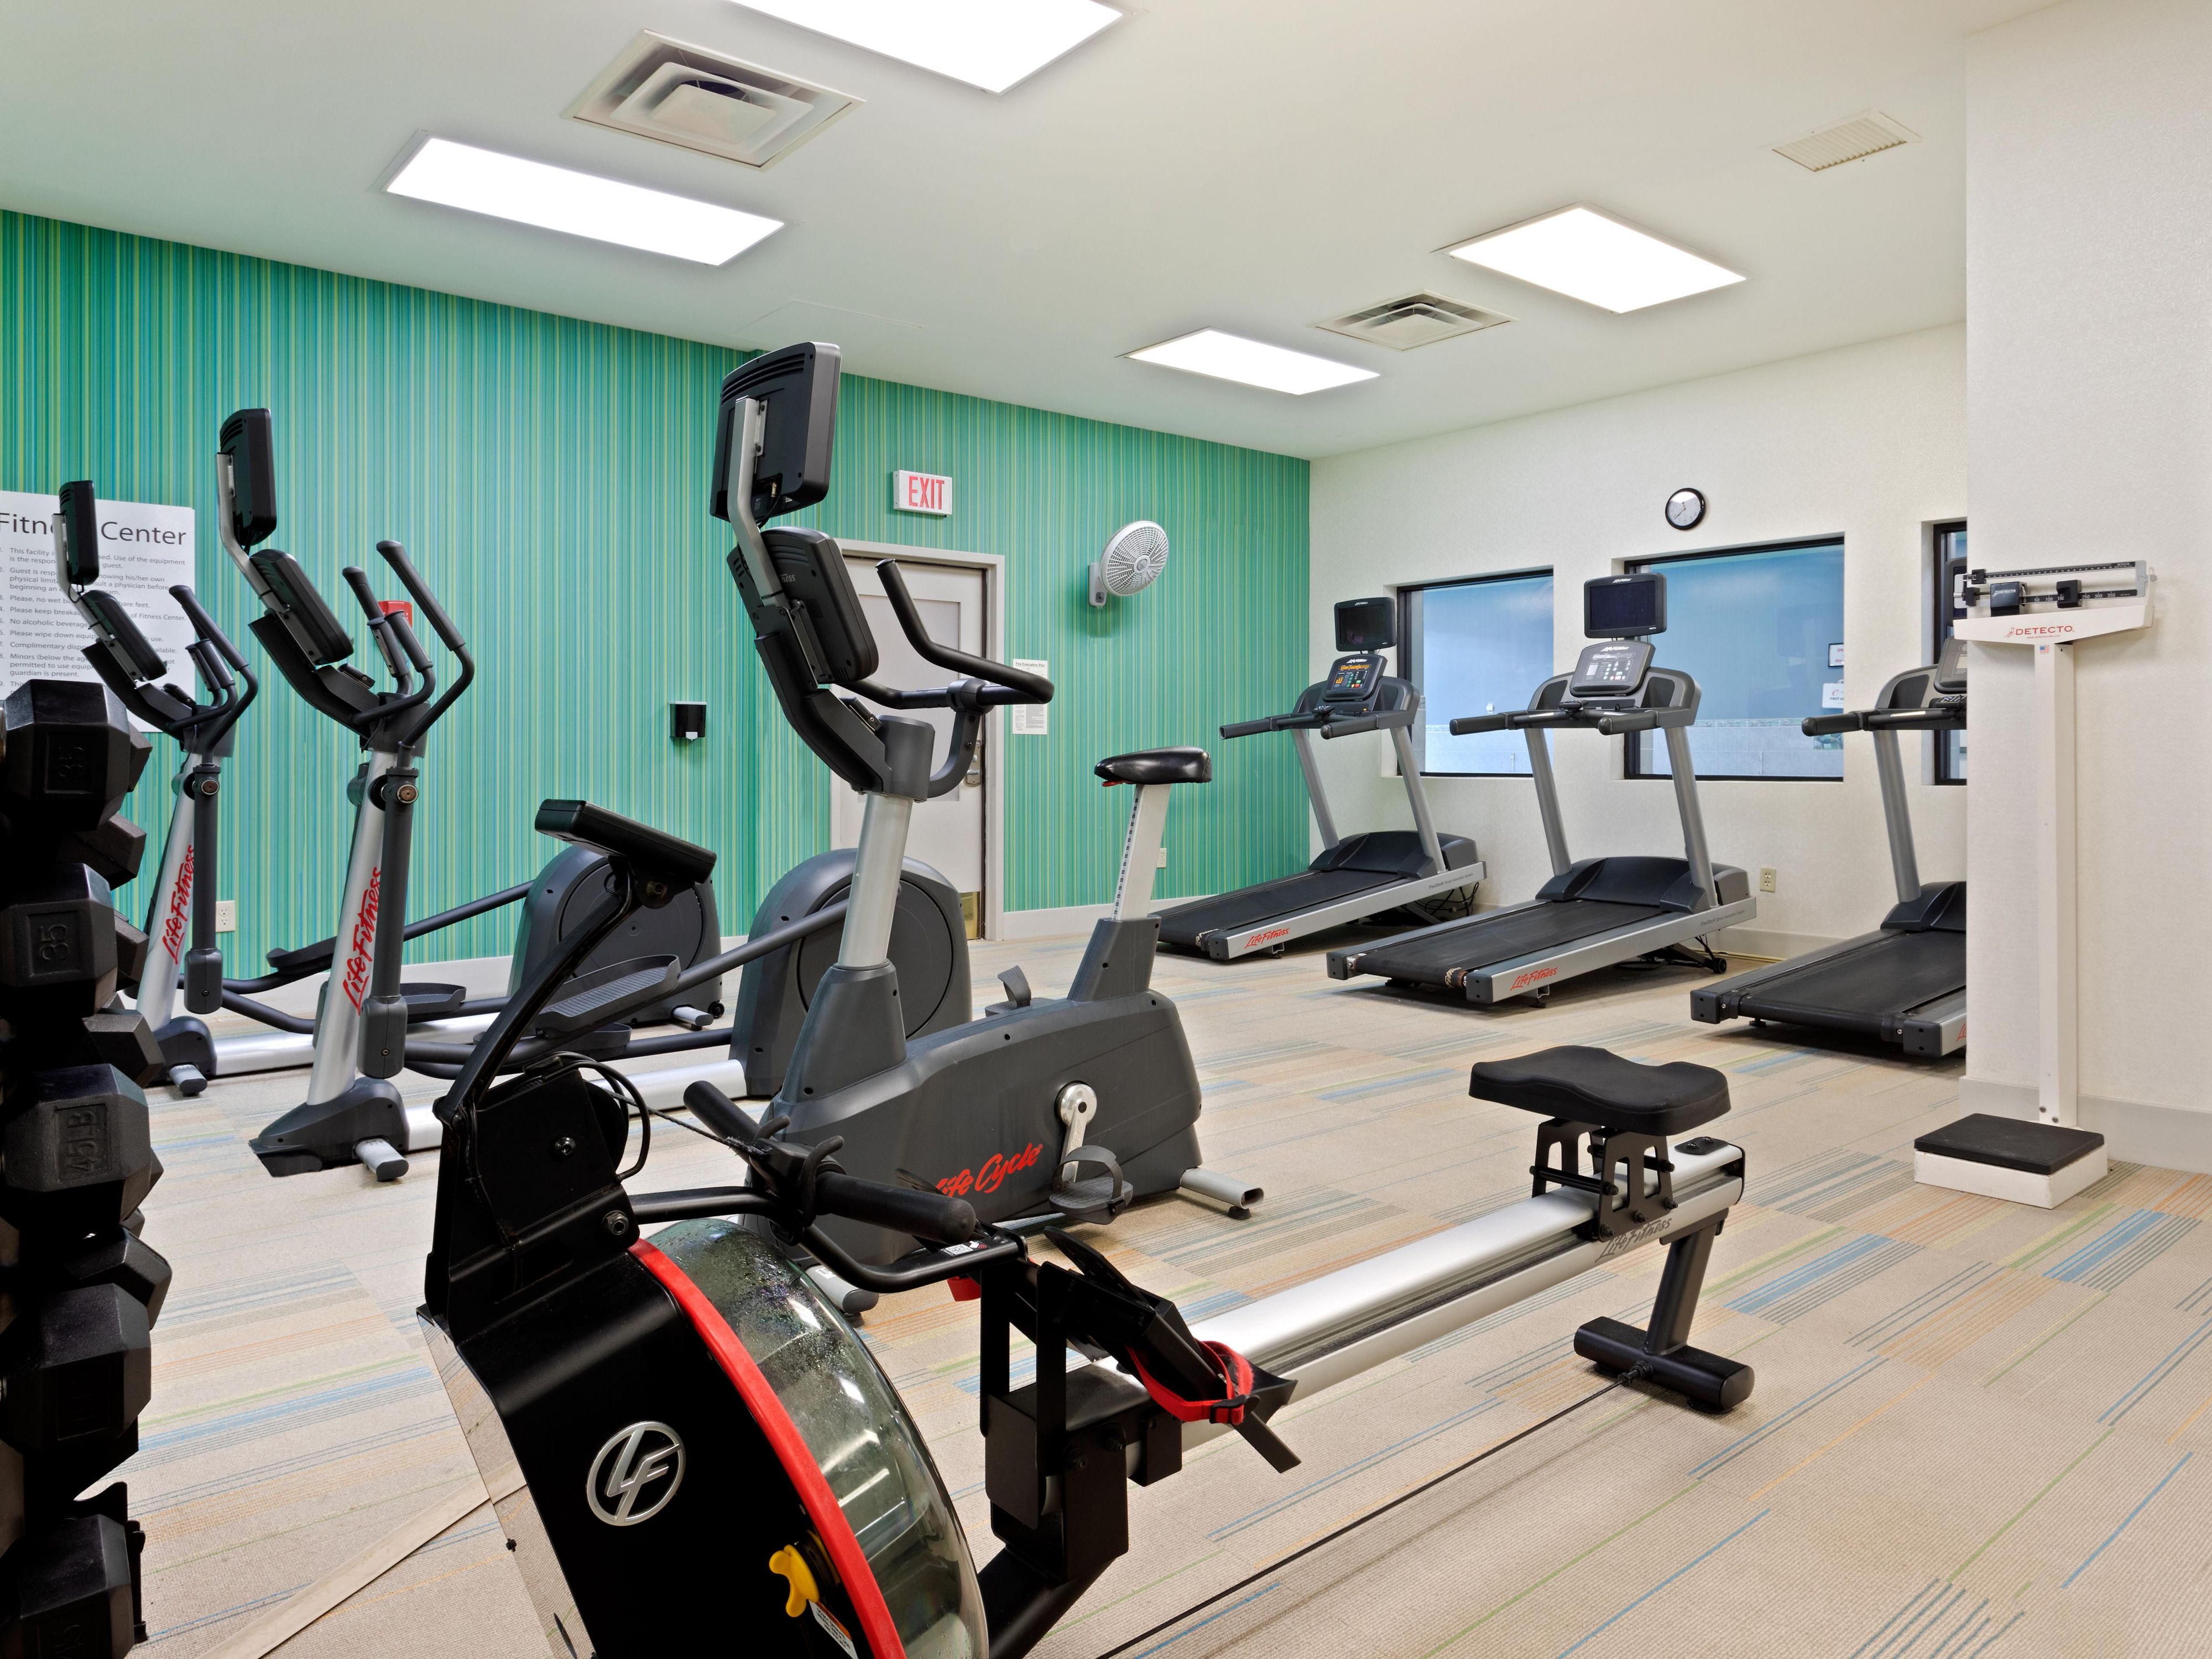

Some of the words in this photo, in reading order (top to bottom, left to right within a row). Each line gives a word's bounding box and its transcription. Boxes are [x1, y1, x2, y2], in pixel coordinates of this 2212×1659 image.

[909, 476, 945, 509] EXIT
[0, 513, 54, 535] Fitn
[101, 521, 186, 545] Center
[27, 549, 50, 557] facility
[2016, 625, 2073, 635] DETECTO
[10, 641, 65, 650] Complimentary
[39, 924, 70, 962] 35
